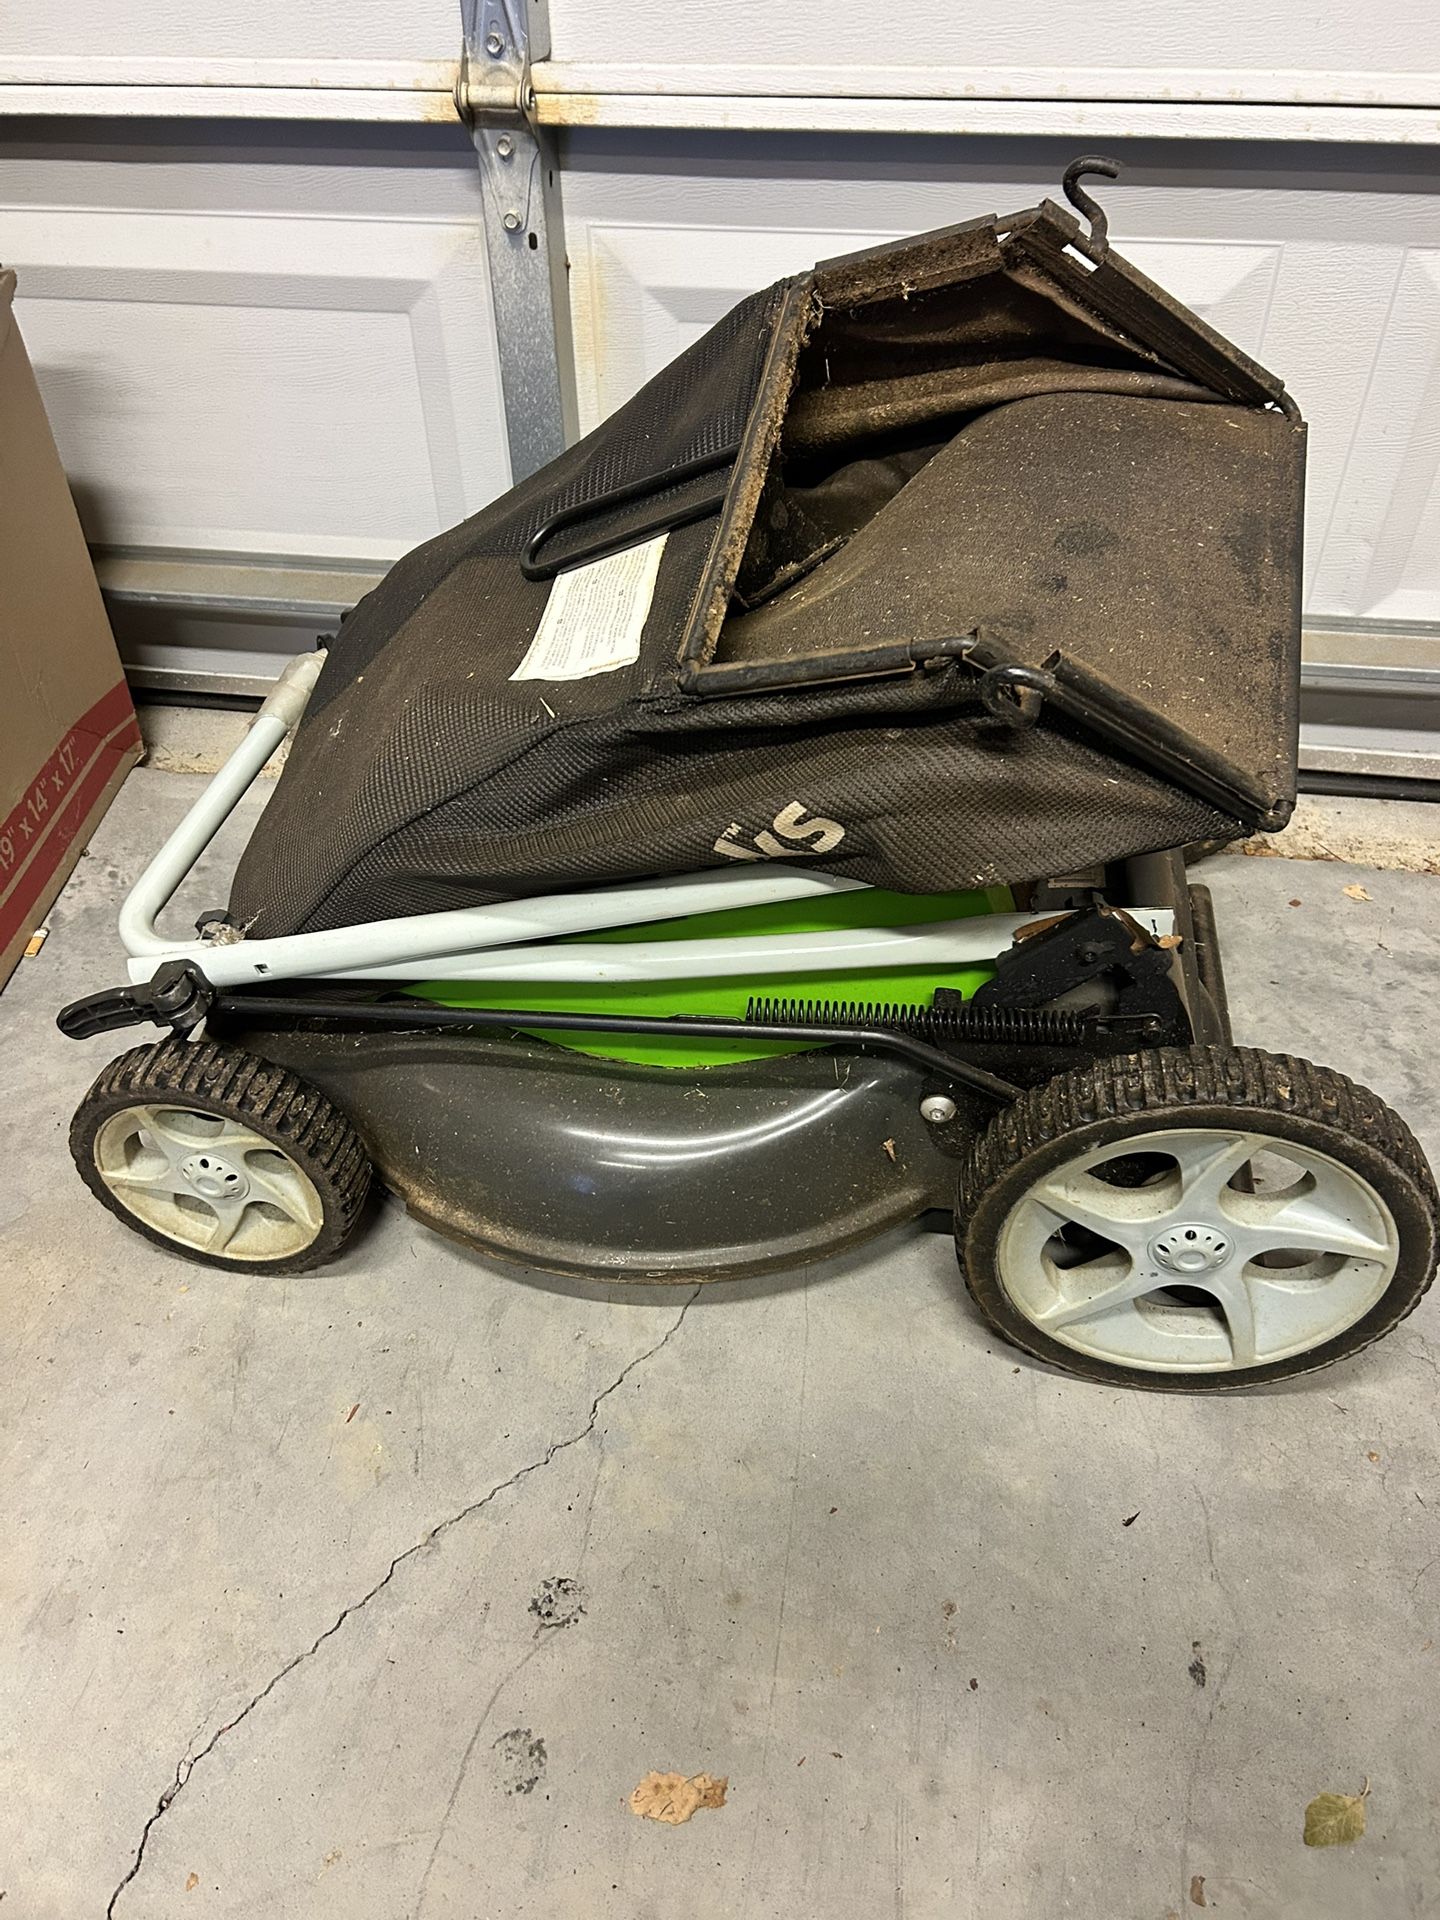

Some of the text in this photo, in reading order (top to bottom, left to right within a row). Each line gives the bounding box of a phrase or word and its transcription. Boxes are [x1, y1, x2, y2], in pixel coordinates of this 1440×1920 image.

[57, 736, 76, 776] 17"
[51, 770, 65, 792] x
[27, 777, 49, 821] 14"
[19, 816, 34, 840] x
